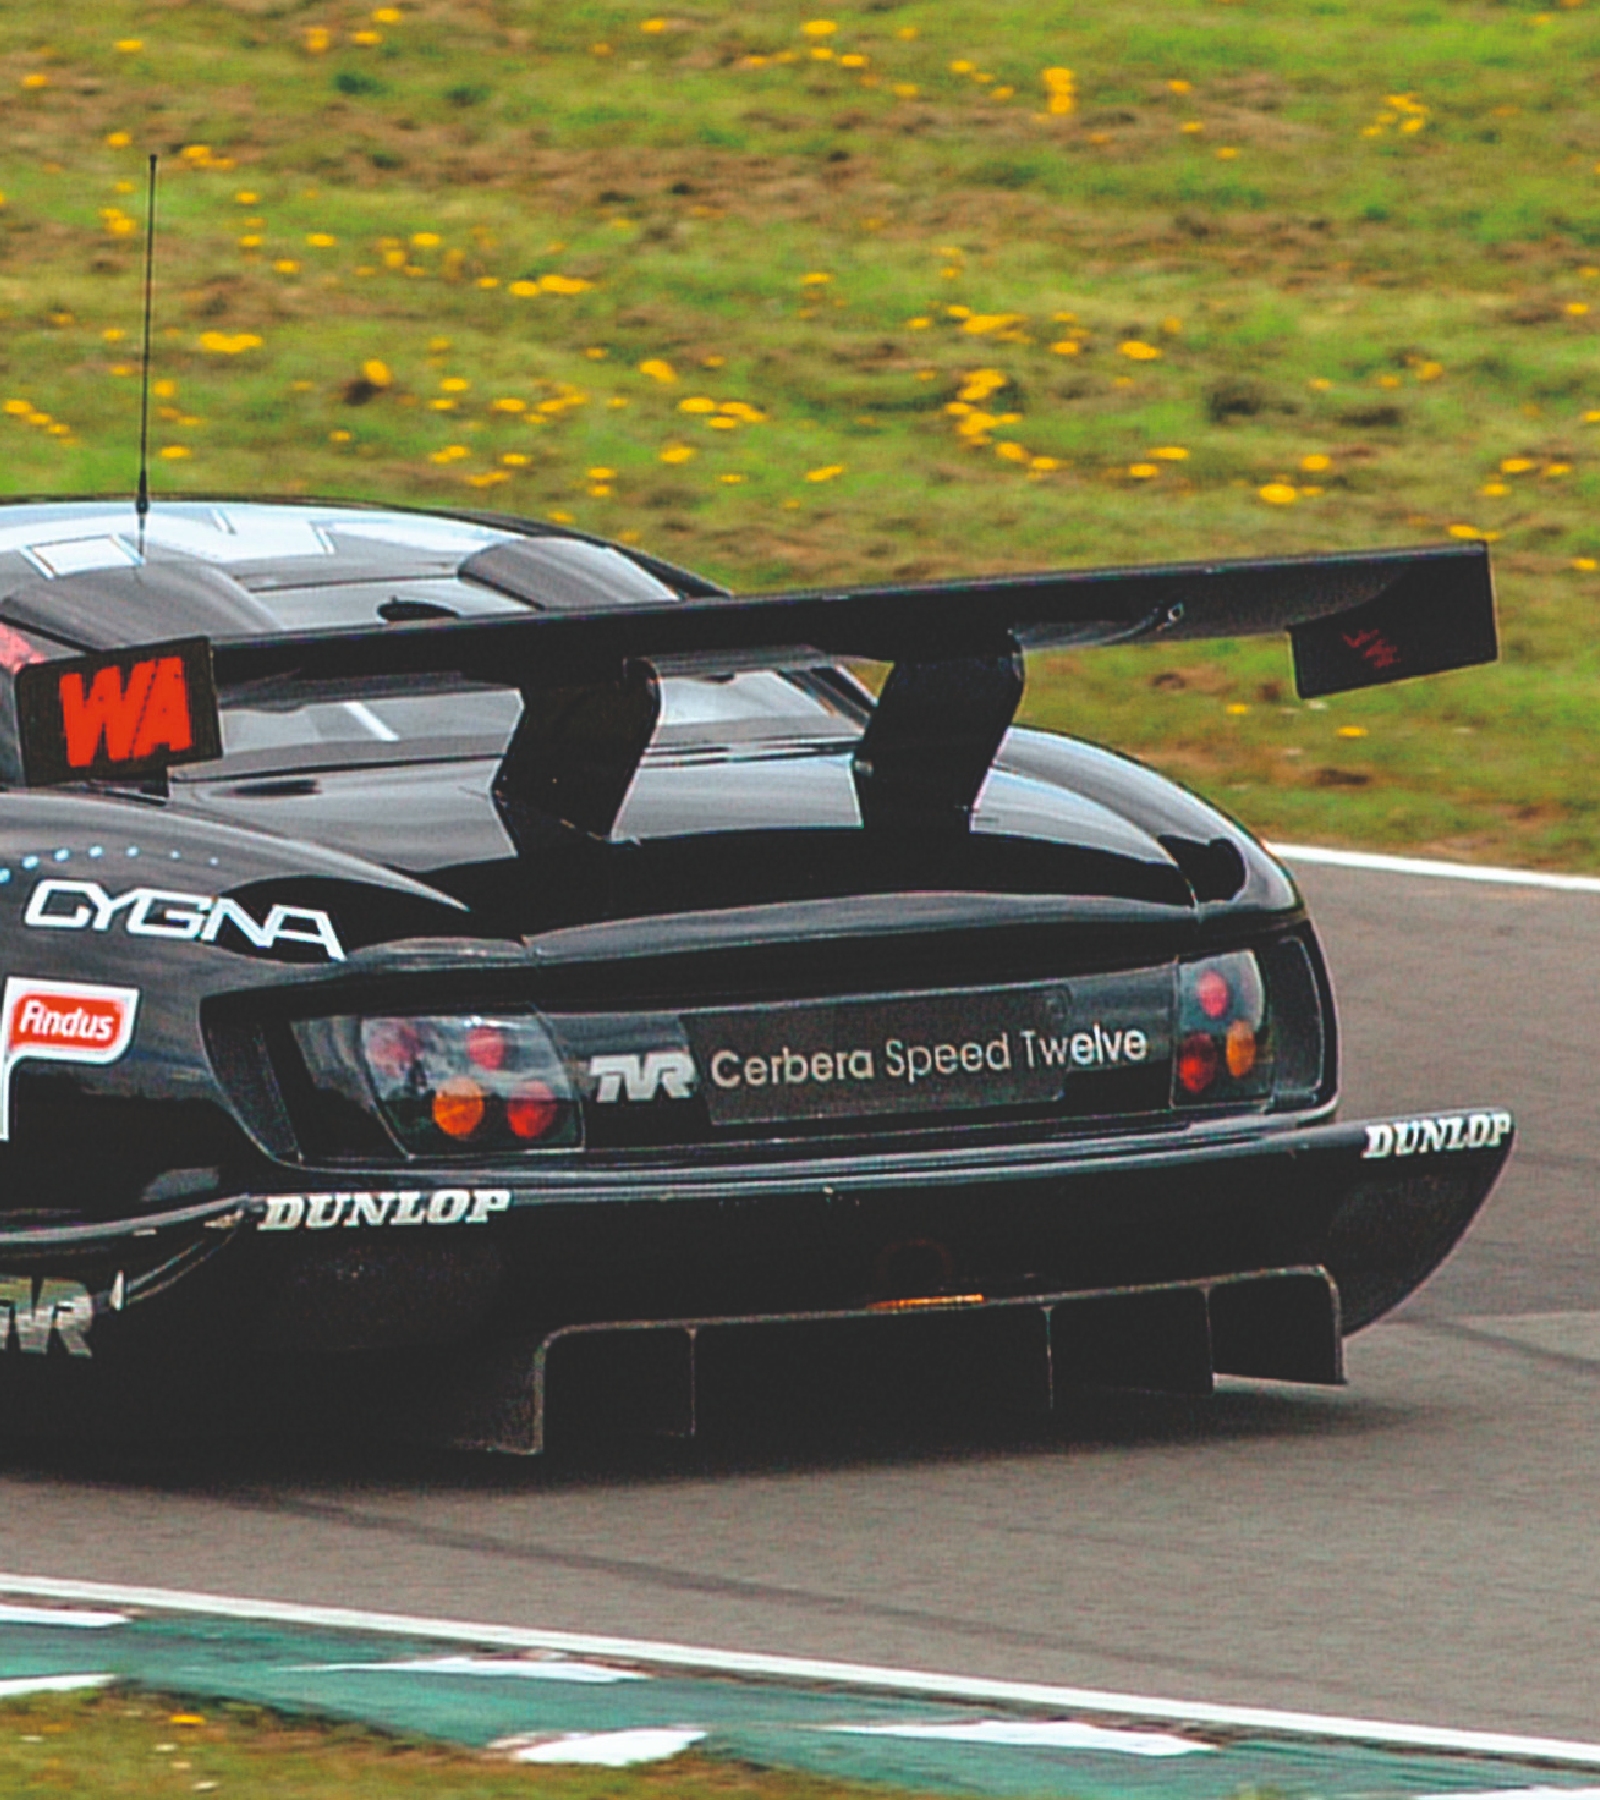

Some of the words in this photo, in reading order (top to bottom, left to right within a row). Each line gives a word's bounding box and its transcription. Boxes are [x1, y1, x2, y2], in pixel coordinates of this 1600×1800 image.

[57, 655, 192, 768] WA
[24, 878, 347, 962] CYGNA
[19, 998, 114, 1042] Findus
[590, 1052, 697, 1104] TVR
[710, 1050, 874, 1088] Cerbera
[885, 1035, 1011, 1084] Speed
[1020, 1022, 1148, 1068] Twelve
[1362, 1112, 1512, 1159] DUNLOP
[257, 1190, 510, 1231] DUNLOP
